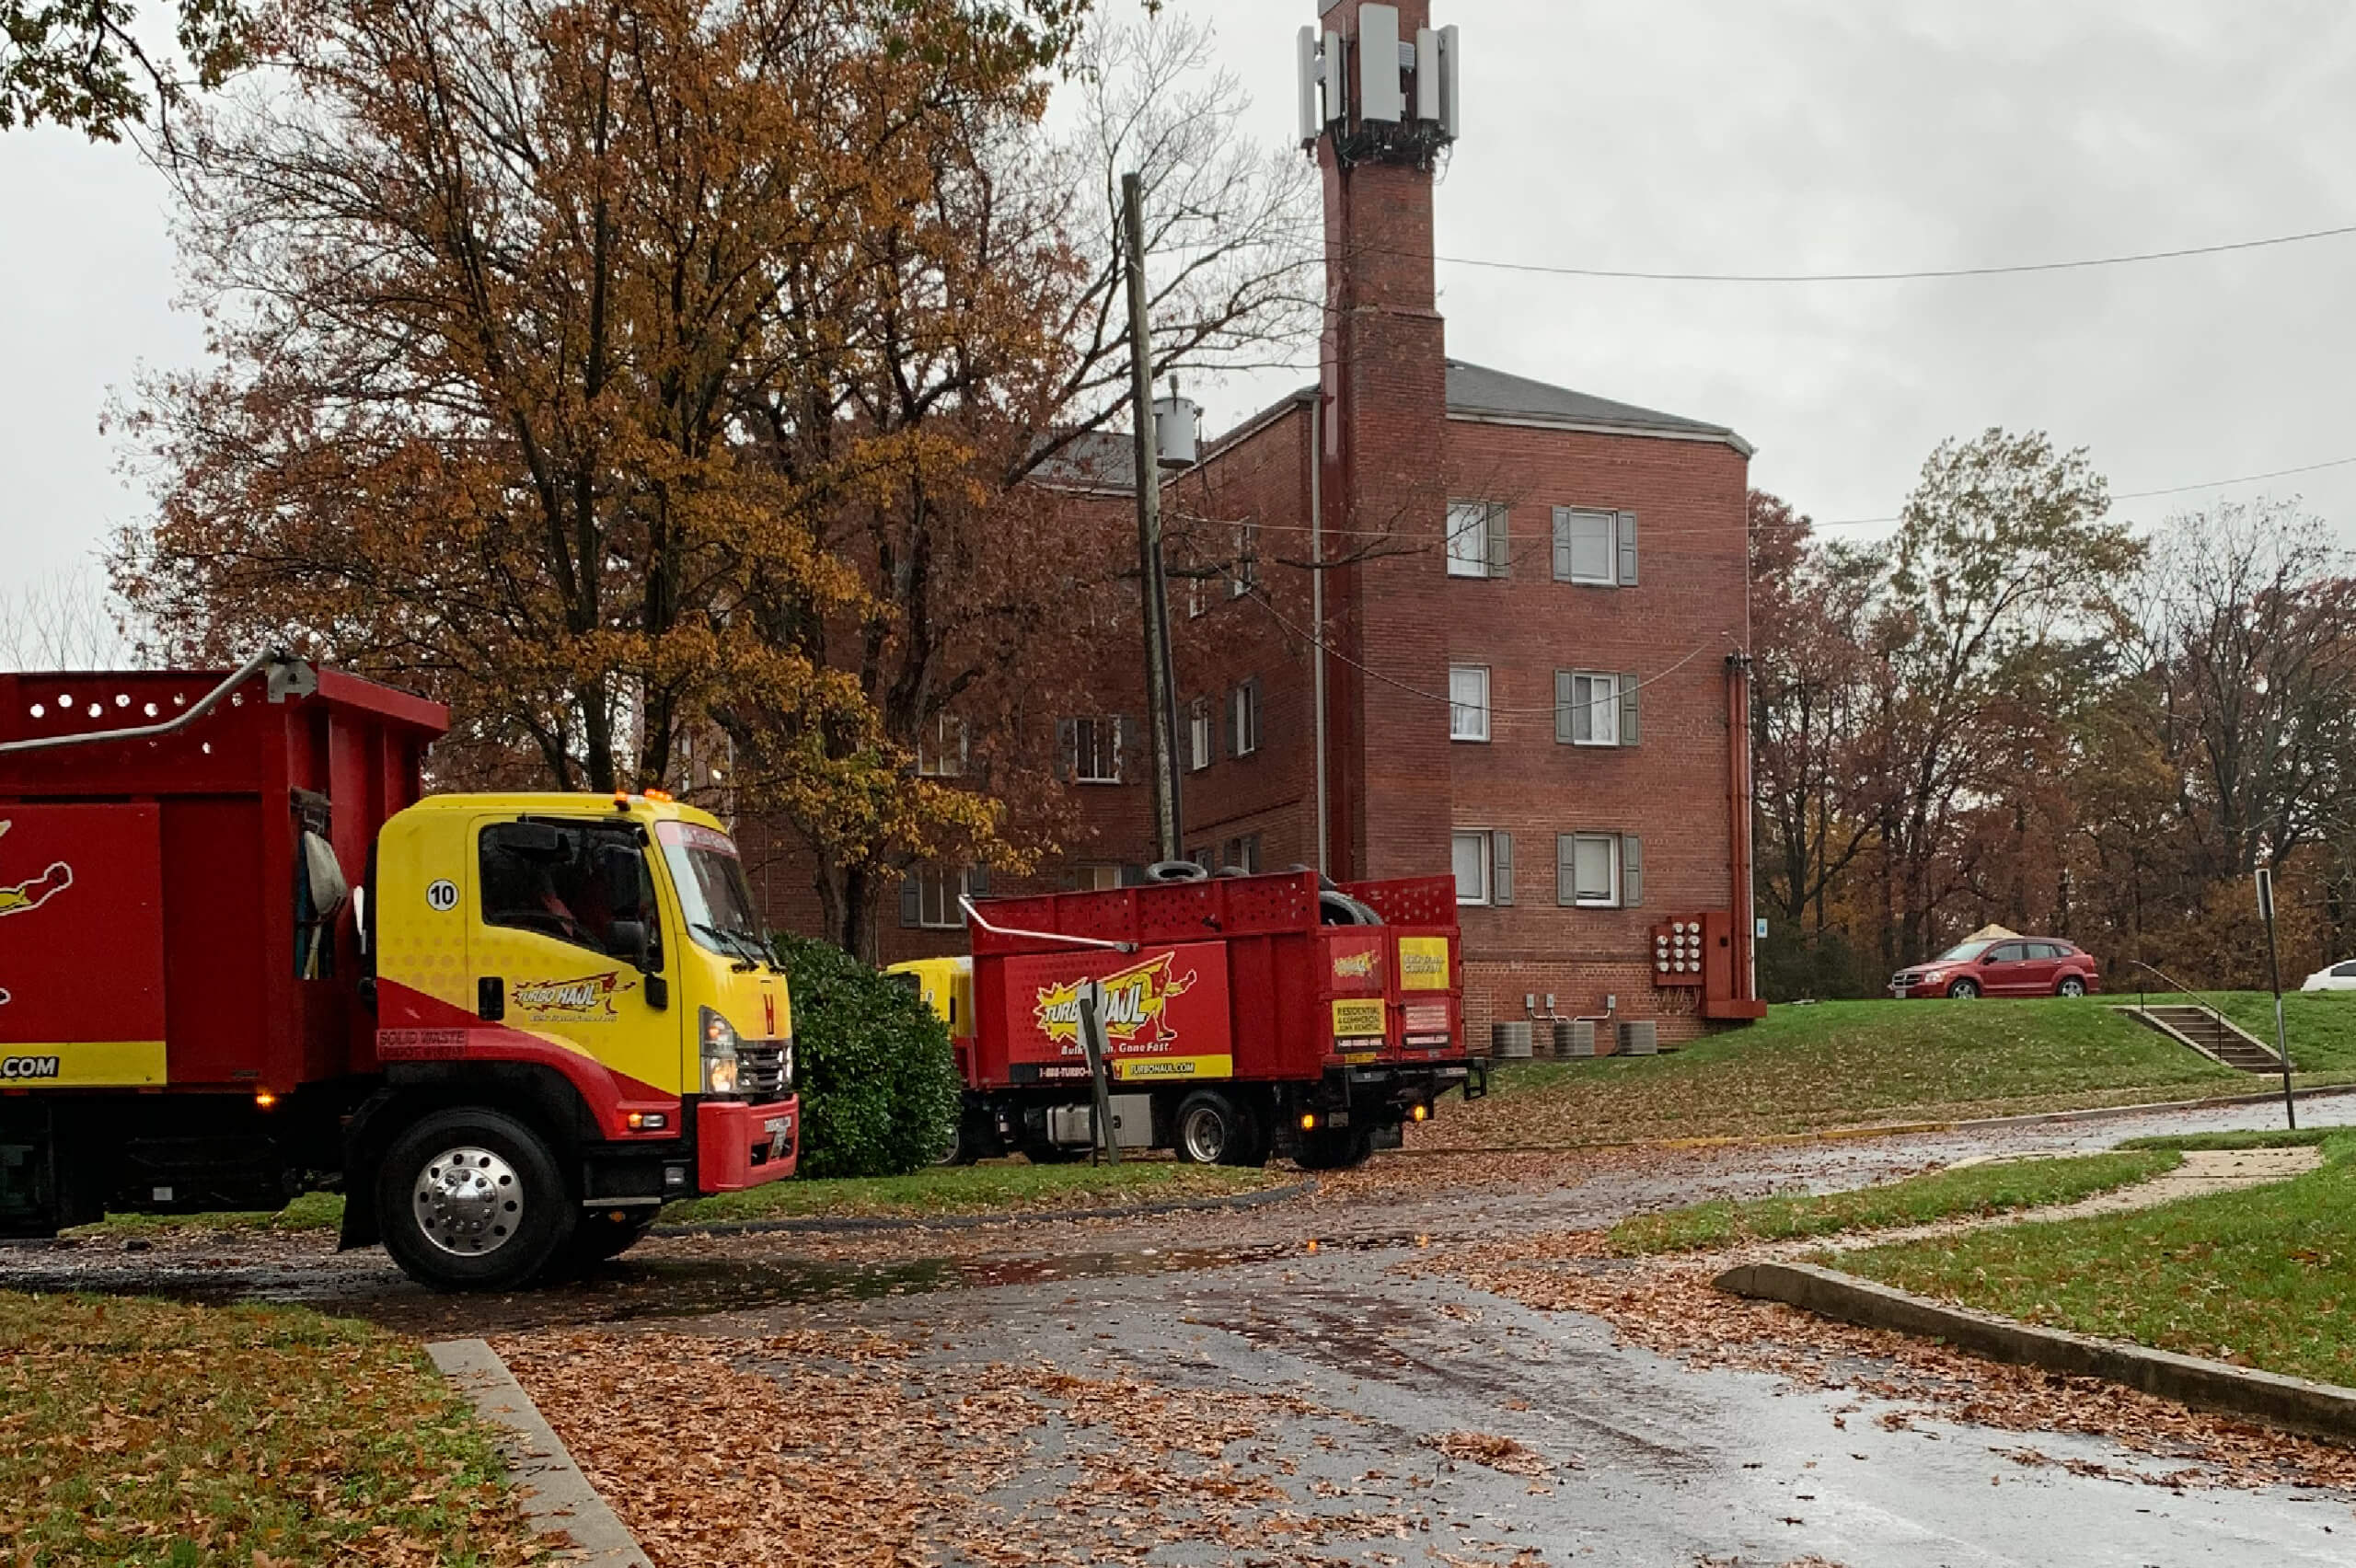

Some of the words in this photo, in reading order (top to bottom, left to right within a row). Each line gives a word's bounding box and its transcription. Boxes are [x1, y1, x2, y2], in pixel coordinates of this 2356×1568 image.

[431, 885, 454, 905] 10
[517, 989, 555, 1003] TURBO
[556, 985, 597, 1005] HAUL
[379, 1031, 418, 1046] SOLID
[1119, 1043, 1145, 1053] Gone
